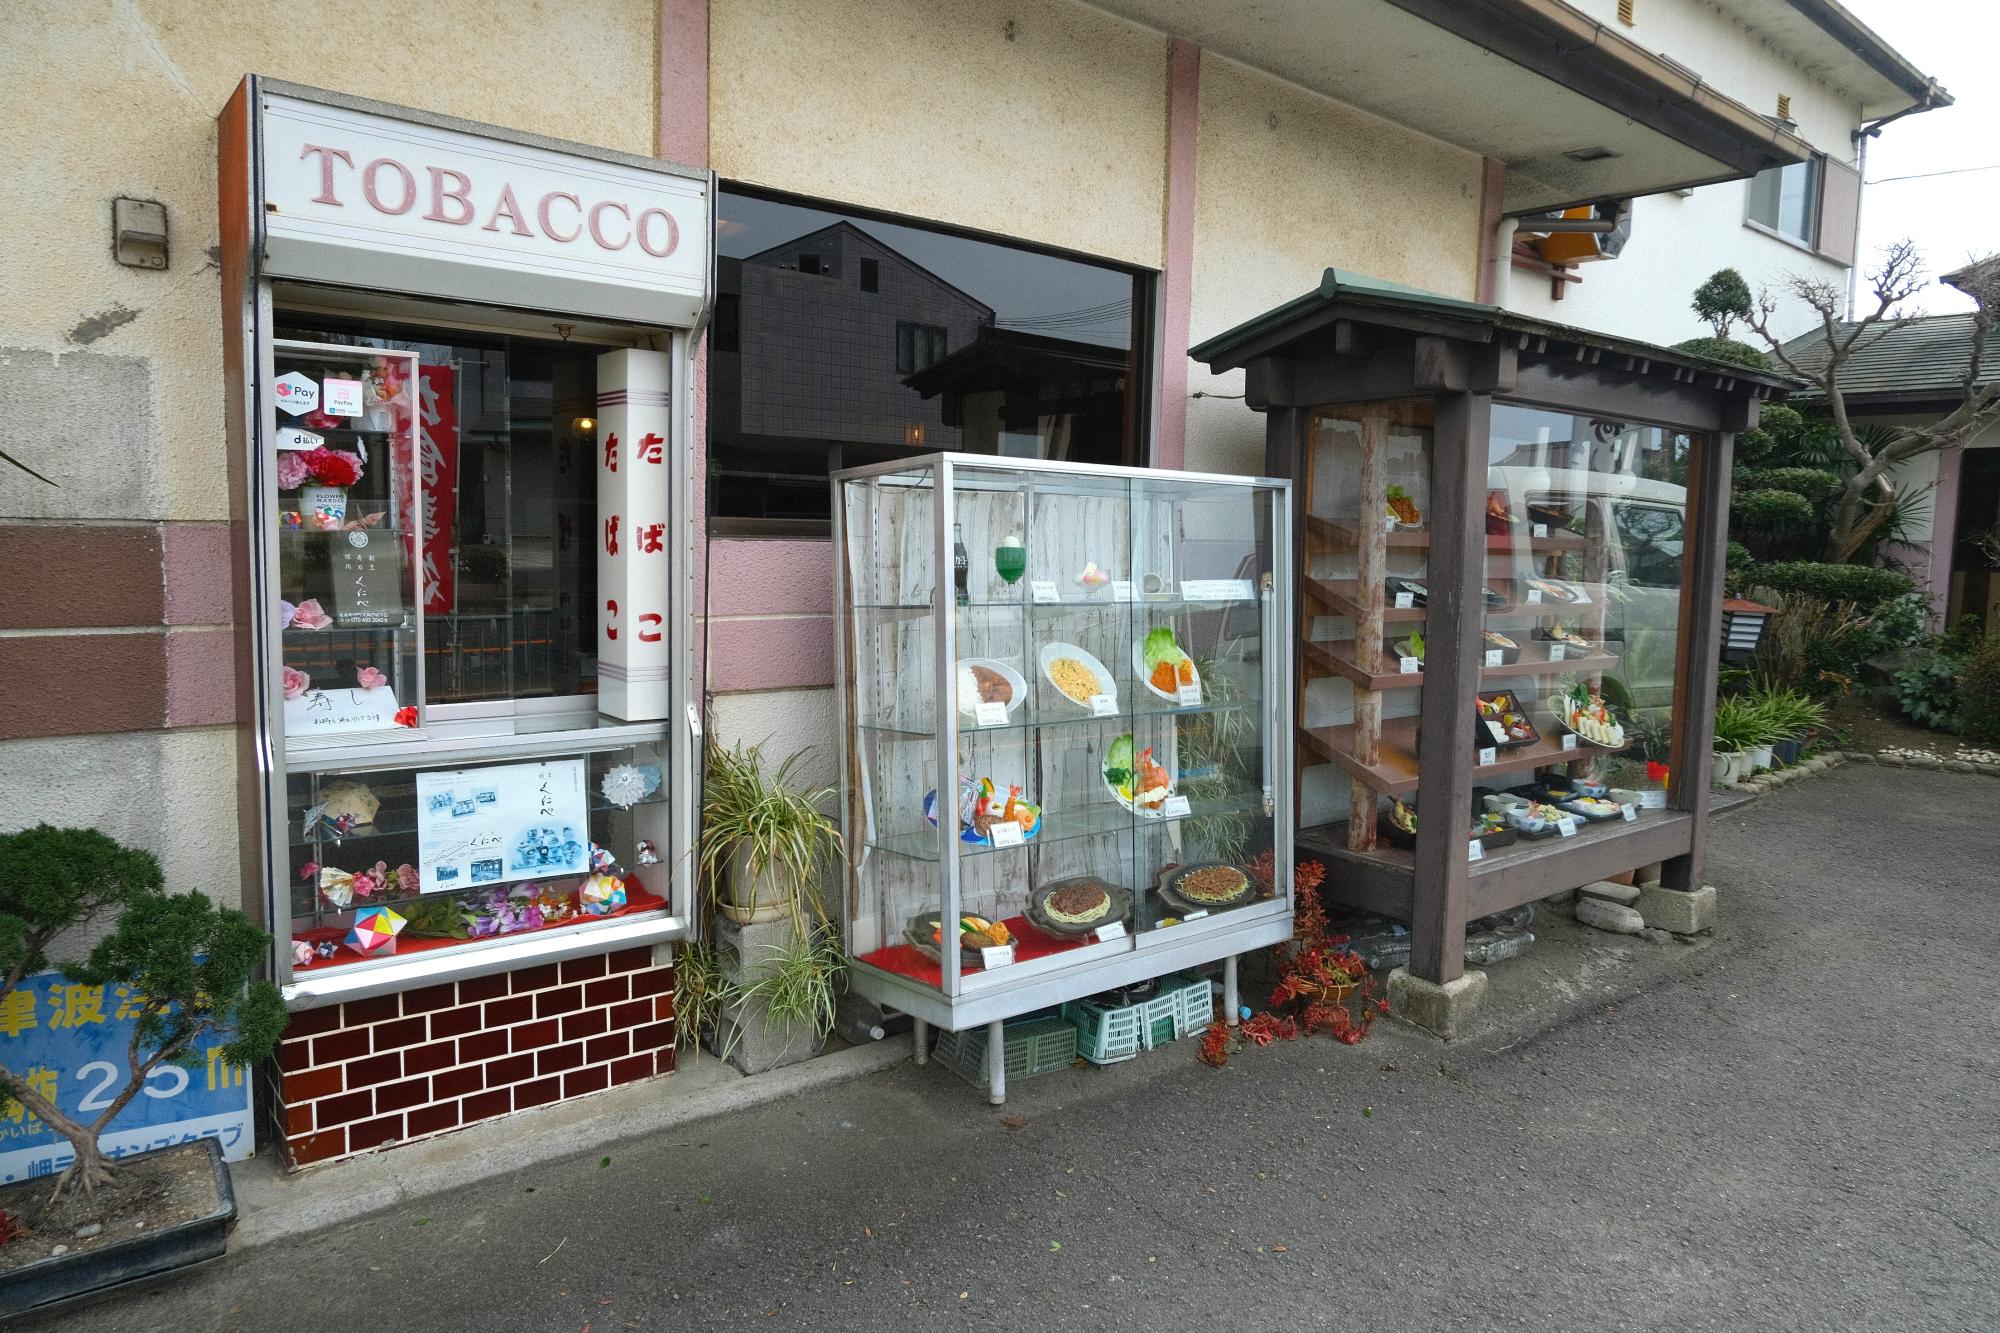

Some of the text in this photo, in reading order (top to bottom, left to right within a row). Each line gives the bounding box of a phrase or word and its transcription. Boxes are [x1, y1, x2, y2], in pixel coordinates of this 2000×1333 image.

[300, 142, 680, 258] TOBACCO
[294, 386, 315, 400] Pay
[333, 399, 353, 407] PayPay
[604, 432, 619, 640] たばこ
[636, 432, 666, 642] たばこ
